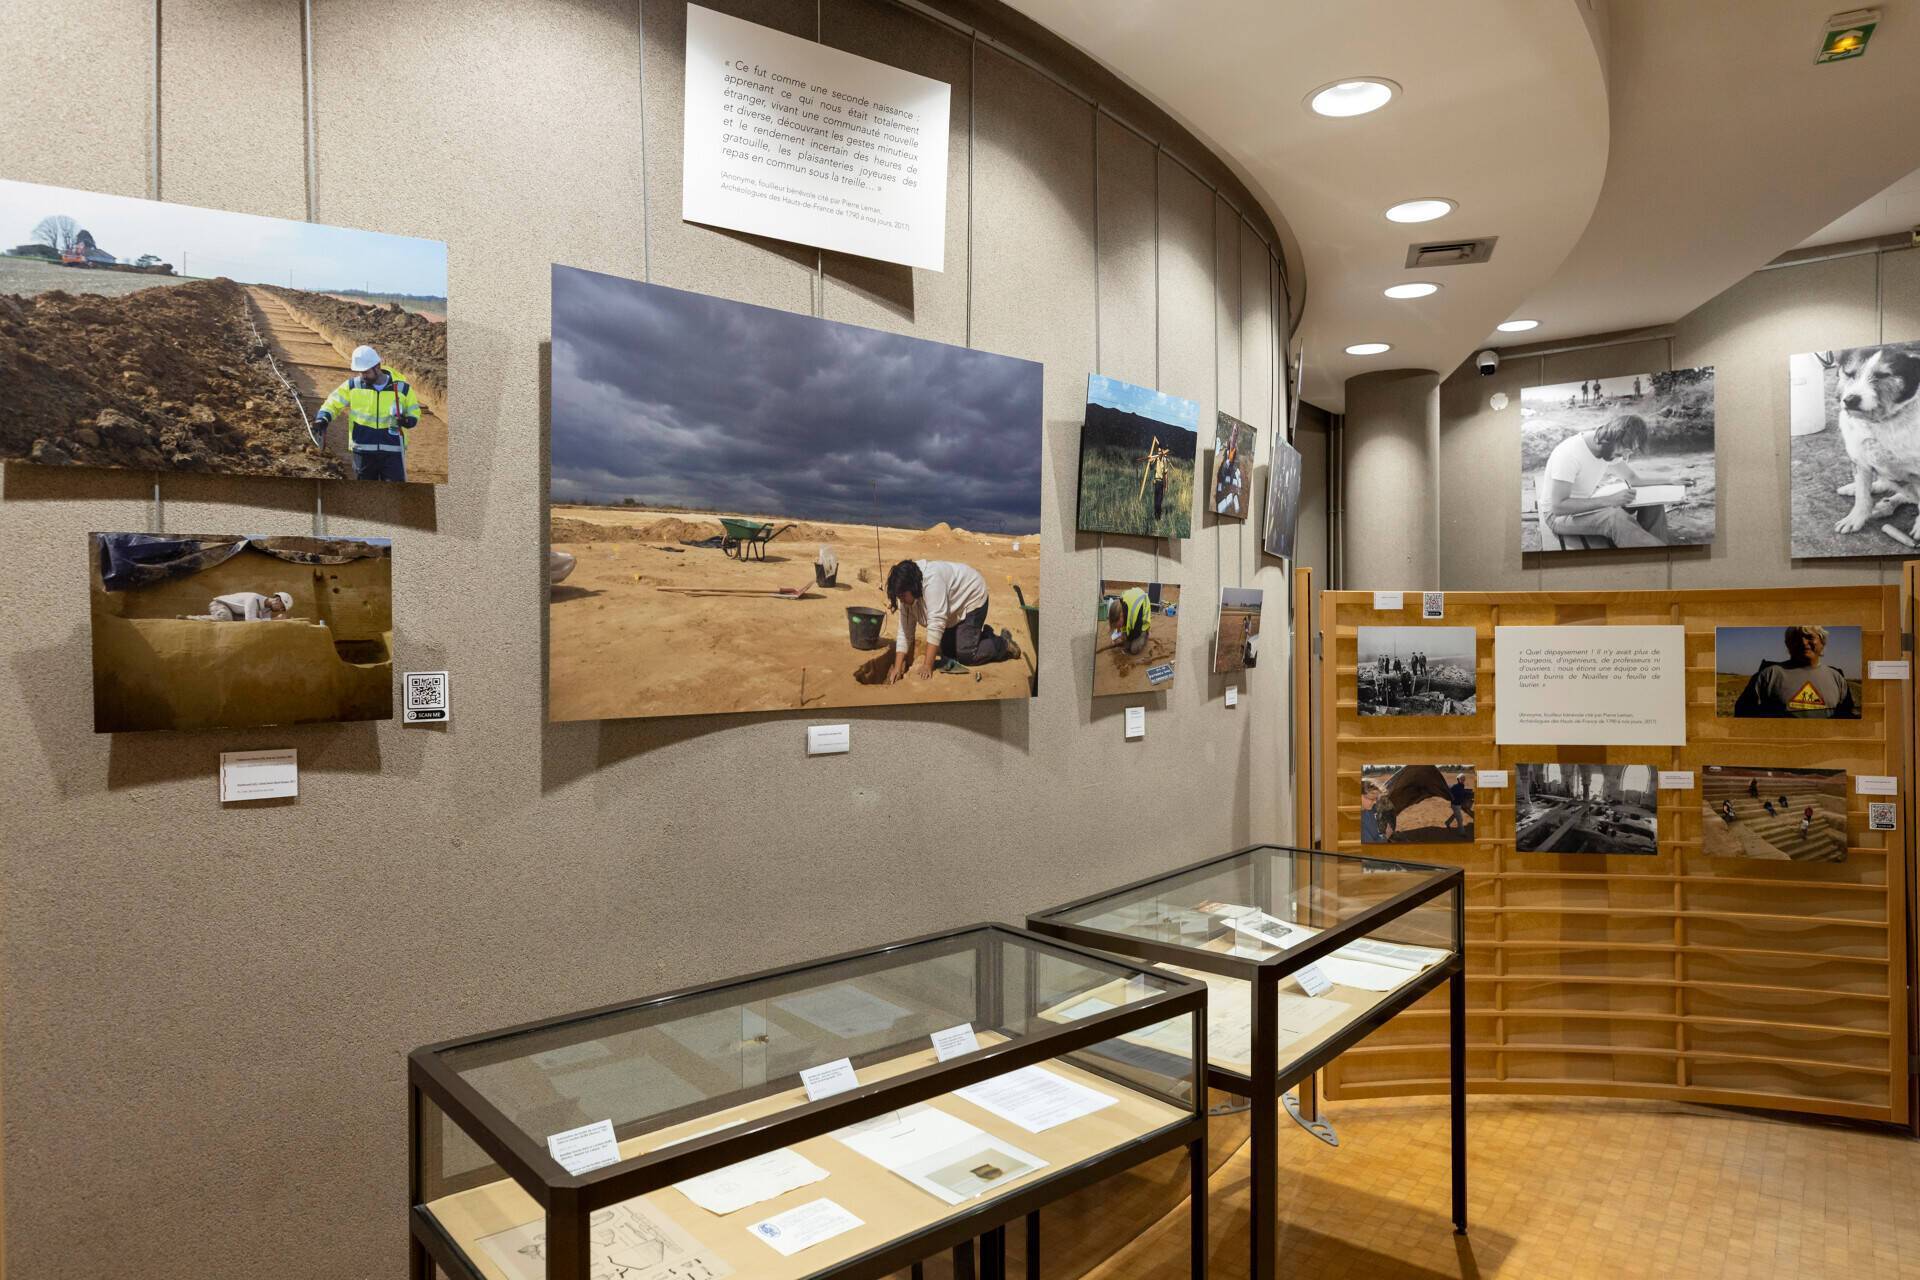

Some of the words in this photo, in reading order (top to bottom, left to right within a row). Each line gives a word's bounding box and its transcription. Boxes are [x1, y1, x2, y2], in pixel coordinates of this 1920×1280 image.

[723, 74, 774, 94] apprenant
[780, 90, 792, 99] ce
[798, 95, 814, 106] qui
[819, 101, 842, 113] nous
[847, 107, 868, 120] était
[873, 115, 919, 135] totalement
[734, 60, 750, 72] Ce
[753, 64, 767, 78] fut
[770, 72, 806, 88] comme
[810, 84, 827, 95] une
[830, 90, 869, 107] seconde
[872, 102, 913, 119] naissance
[723, 86, 766, 108] étranger,
[771, 100, 798, 116] vivant
[801, 109, 819, 121] une
[822, 116, 880, 137] communauté
[883, 132, 918, 148] nouvelle
[723, 103, 734, 112] et
[736, 104, 773, 124] diverse,
[776, 116, 828, 138] découvrant
[831, 129, 843, 141] les
[845, 136, 874, 150] gestes
[876, 144, 918, 161] minutieux
[721, 147, 749, 160] repas
[751, 154, 763, 163] en
[766, 158, 806, 173] commun
[807, 168, 829, 180] sous
[831, 170, 839, 182] la
[722, 118, 733, 127] et
[738, 118, 747, 130] le
[753, 126, 805, 146] rendement
[810, 138, 848, 156] incertain
[853, 150, 869, 162] des
[873, 154, 901, 171] heures
[906, 164, 917, 174] de
[722, 132, 770, 152] gratouille,
[777, 143, 791, 156] les
[797, 149, 853, 172] plaisanteries
[858, 167, 896, 182] joyeuses
[902, 175, 917, 188] des
[720, 170, 757, 186] (Anonyme,
[758, 179, 785, 192] fouilleur
[786, 185, 816, 199] bénévole
[816, 193, 829, 202] cité
[841, 198, 859, 209] Pierre
[720, 182, 767, 198] Archéologues
[768, 193, 780, 202] des
[782, 195, 834, 214] Hauts-de-France
[865, 215, 876, 223] nos
[876, 217, 893, 228] jours,
[1518, 657, 1553, 665] bourgeois,
[1555, 657, 1598, 665] d'ingénieurs,
[1612, 657, 1651, 665] professeurs
[1653, 657, 1661, 665] ni
[1518, 665, 1551, 673] d'ouvriers
[1557, 665, 1574, 673] nous
[1576, 665, 1596, 673] étions
[1613, 665, 1638, 673] équipe
[1525, 649, 1542, 657] Quel
[1544, 649, 1588, 657] dépaysement
[1603, 649, 1614, 657] n'y
[1634, 649, 1649, 657] plus
[1518, 673, 1540, 681] parlait
